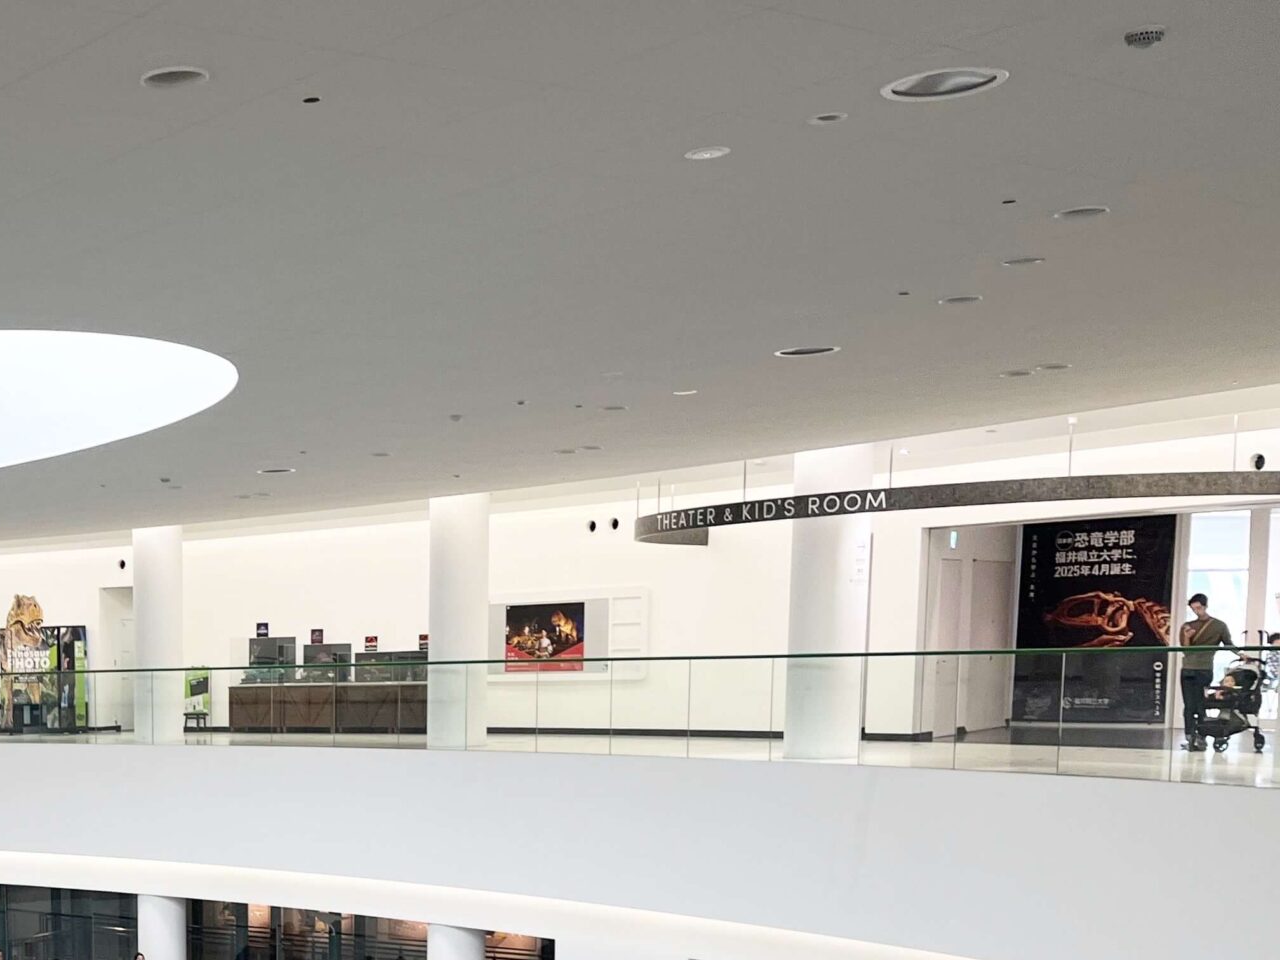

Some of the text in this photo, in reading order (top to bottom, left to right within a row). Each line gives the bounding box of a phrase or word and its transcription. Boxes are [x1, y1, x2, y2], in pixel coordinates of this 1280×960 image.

[657, 491, 887, 531] THEATER & KID'S ROOM
[1074, 530, 1135, 547] 恐竜学部
[7, 657, 50, 669] PHOTO
